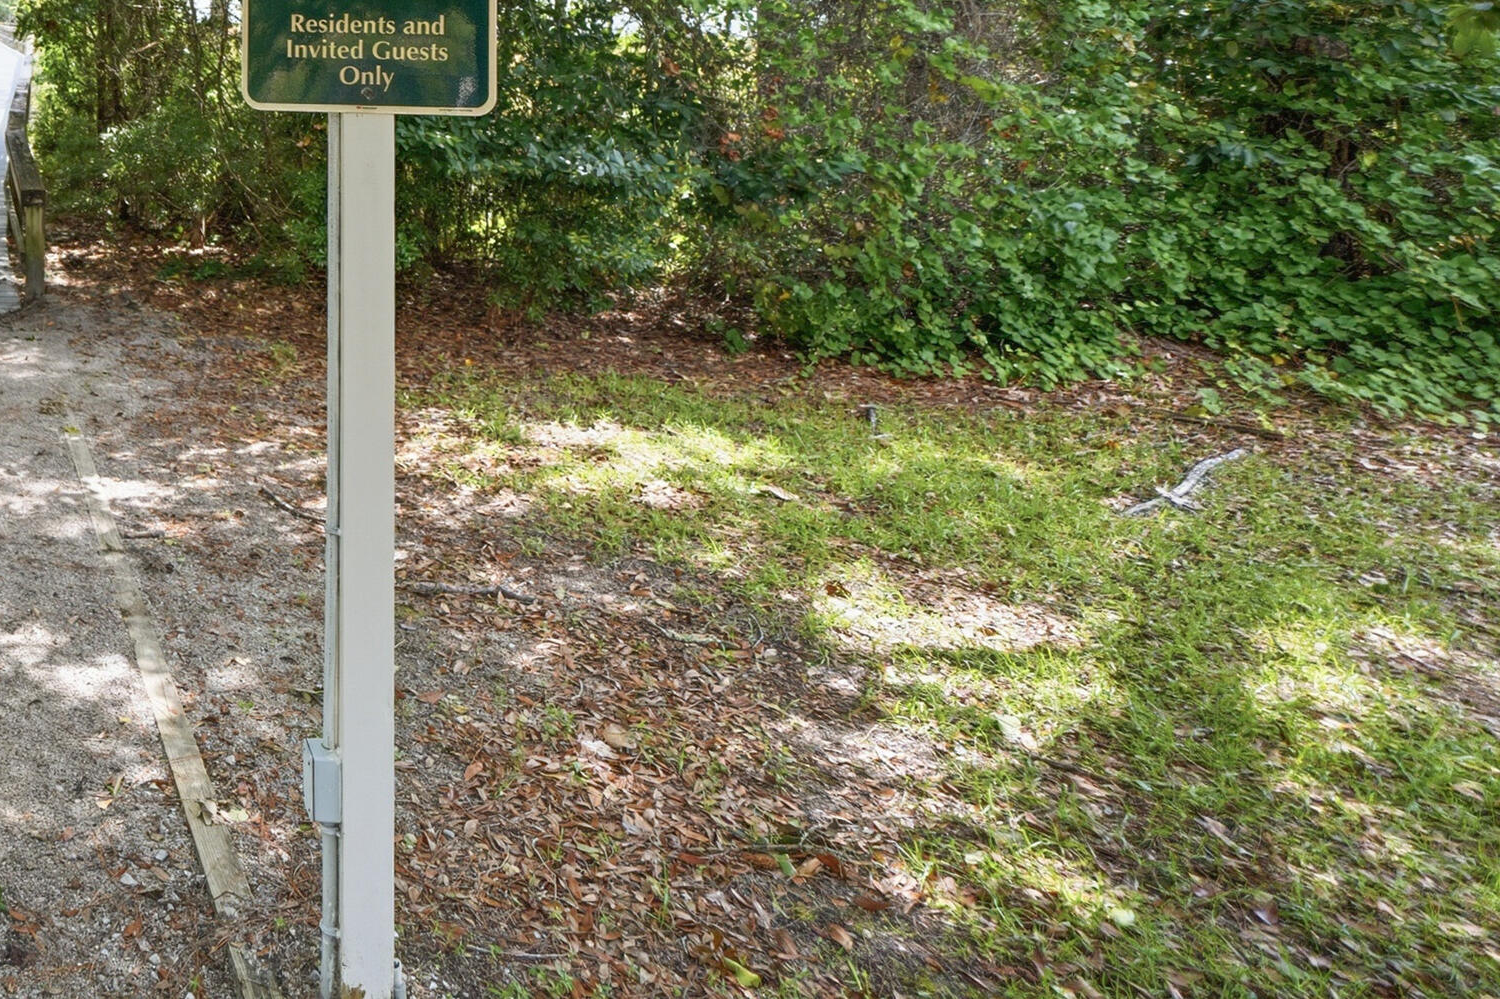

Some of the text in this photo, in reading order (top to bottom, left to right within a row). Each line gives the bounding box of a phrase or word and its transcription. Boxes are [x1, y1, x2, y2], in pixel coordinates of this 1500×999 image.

[290, 12, 445, 36] Residents and
[286, 38, 449, 62] Invited Guests
[338, 64, 395, 92] Only
